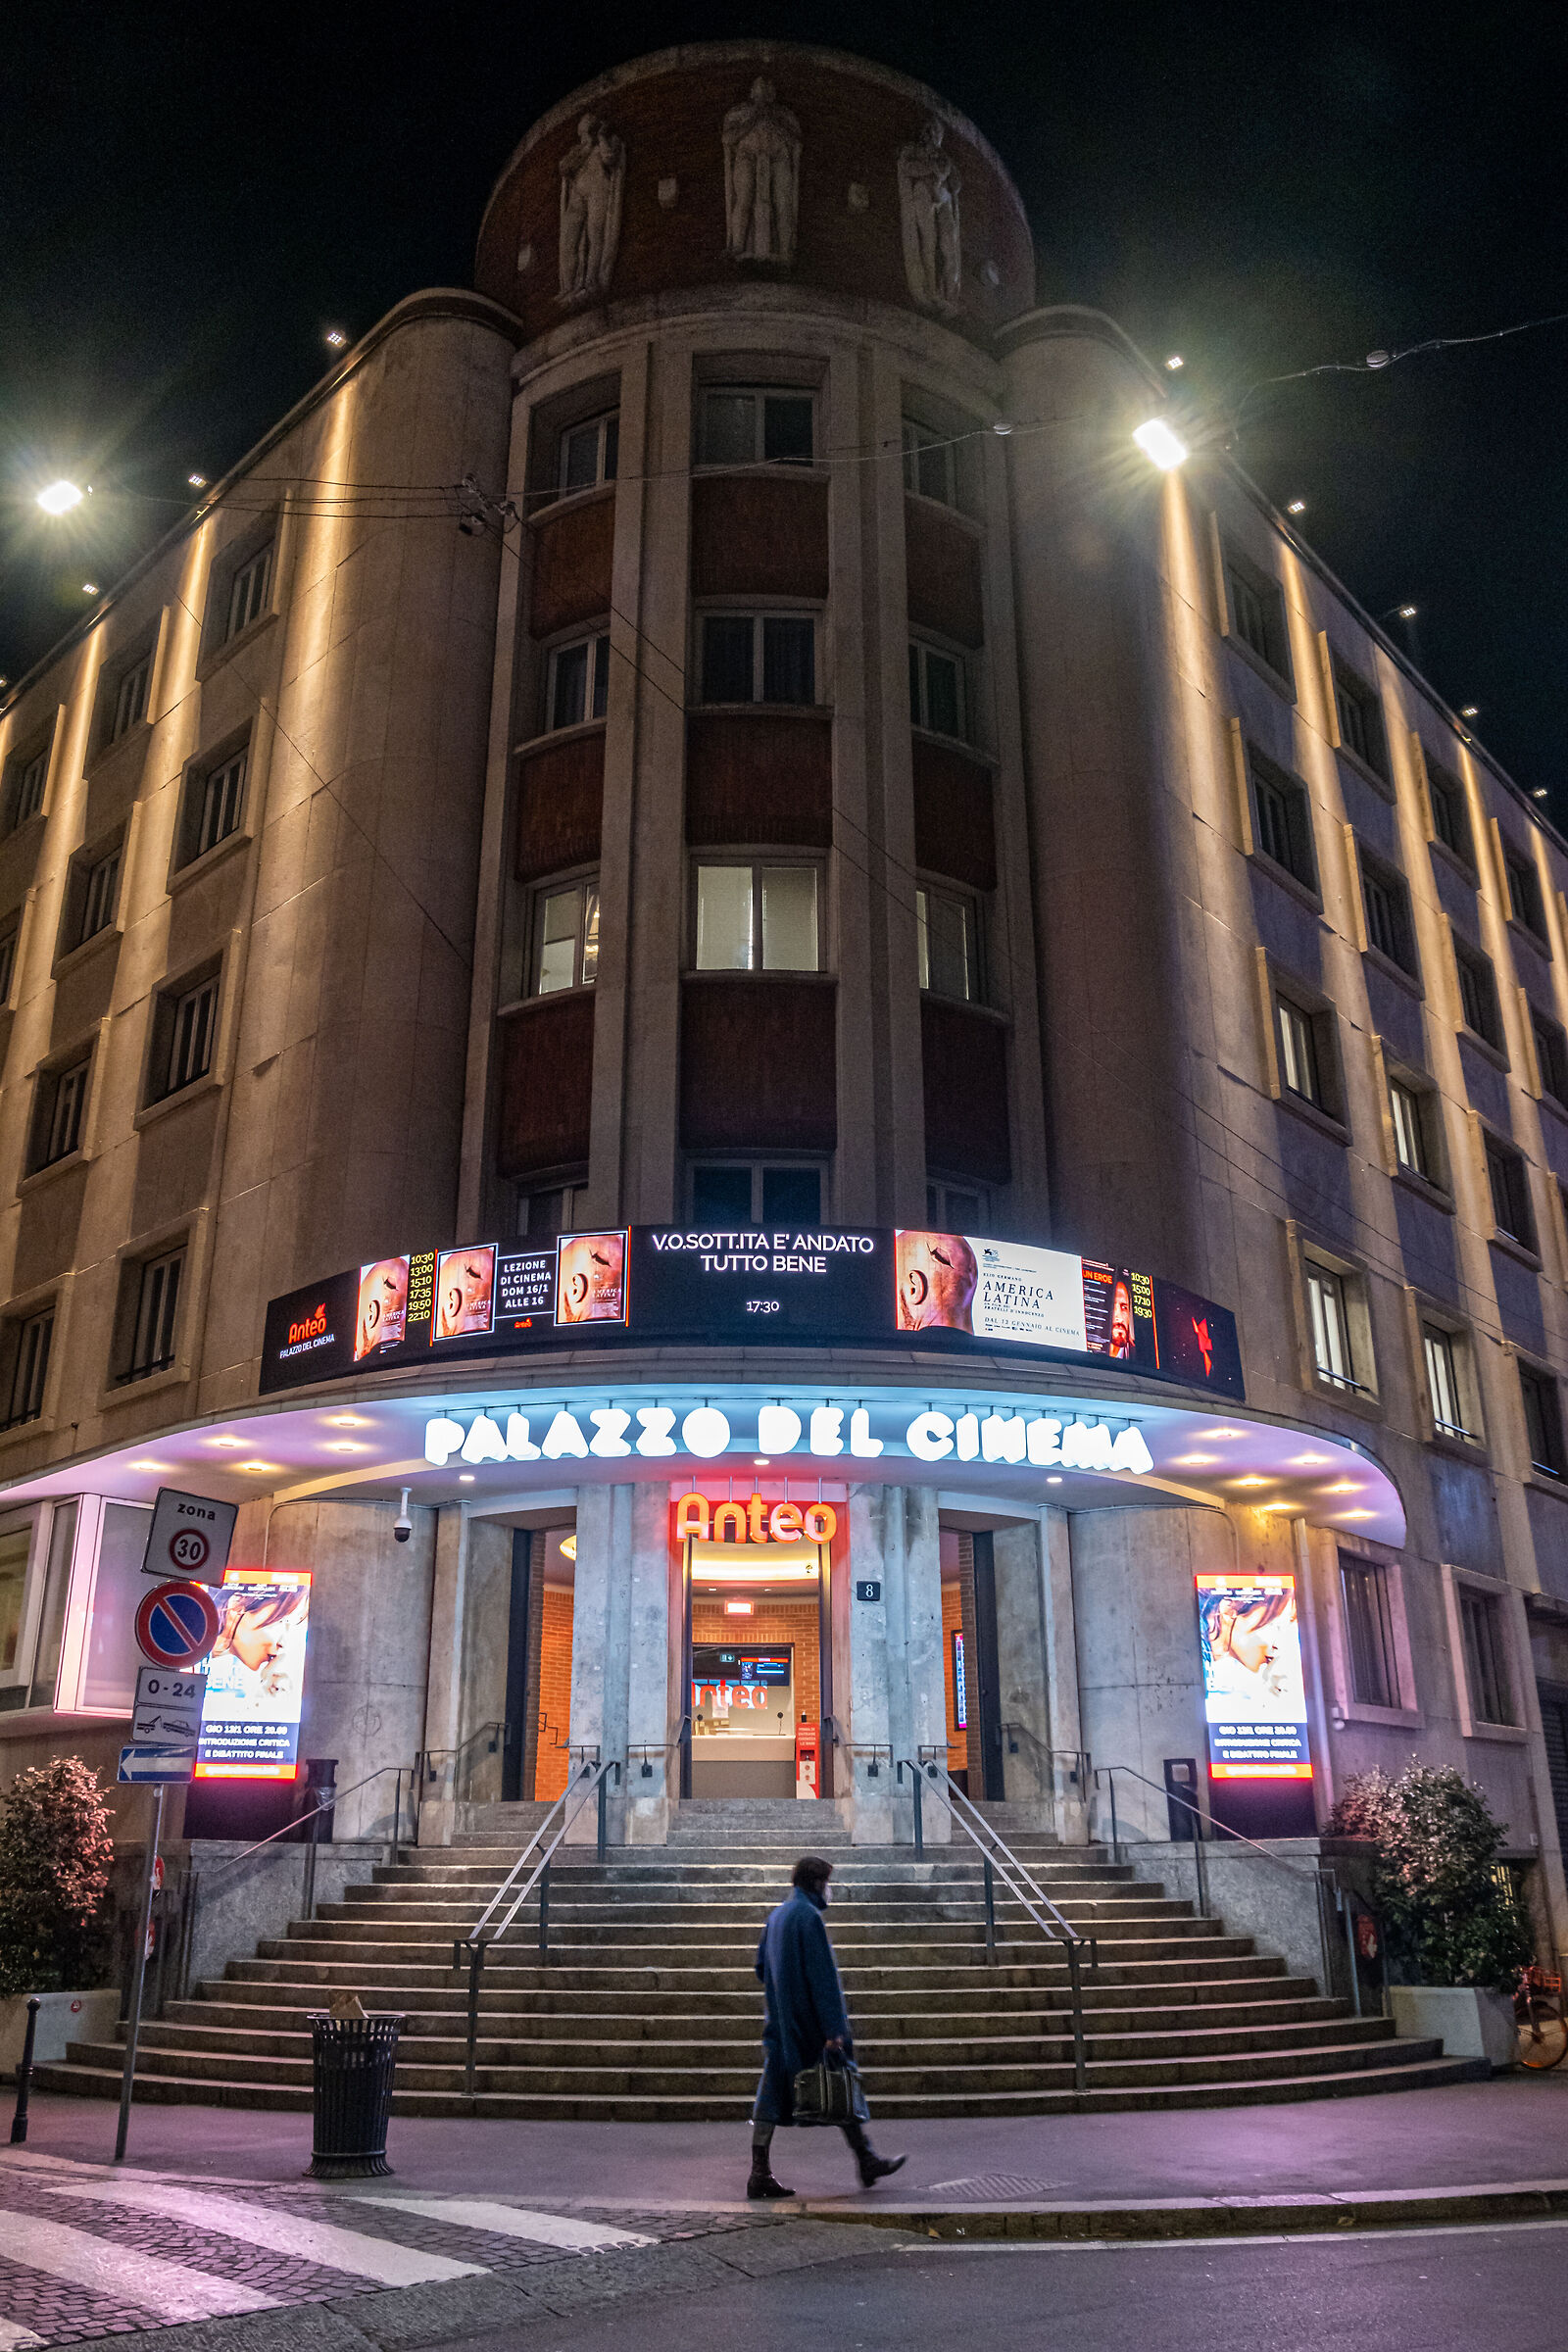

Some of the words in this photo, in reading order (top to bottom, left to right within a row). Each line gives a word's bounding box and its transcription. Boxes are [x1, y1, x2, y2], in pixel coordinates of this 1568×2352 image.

[773, 1233, 790, 1250] E'
[792, 1234, 874, 1253] ANDATO
[504, 1259, 546, 1273] LEZIONE
[700, 1254, 768, 1272] TUTTO
[772, 1255, 827, 1273] BENE
[500, 1276, 512, 1286] DI
[513, 1271, 552, 1284] CINEMA
[1083, 1270, 1093, 1280] UN
[1094, 1272, 1113, 1284] EROE
[501, 1286, 524, 1297] DOM
[526, 1284, 549, 1295] 16/1
[983, 1280, 1054, 1300] AMERICA
[505, 1298, 529, 1308] ALLE
[531, 1296, 544, 1305] 16
[746, 1300, 780, 1313] 17:30
[983, 1291, 1040, 1309] LATINA
[288, 1317, 327, 1345] Anteo
[279, 1345, 302, 1358] PALAZZO
[302, 1341, 313, 1351] DEL
[313, 1333, 334, 1348] CINEMA
[424, 1407, 731, 1466] PALAZZO
[758, 1405, 883, 1458] DEL
[906, 1410, 1154, 1475] CINEMA
[177, 1503, 216, 1521] zona
[676, 1492, 838, 1544] Anteo
[177, 1539, 201, 1560] 30
[865, 1584, 874, 1597] 8
[691, 1680, 768, 1710] nteo
[243, 1725, 264, 1735] ORE
[258, 1739, 291, 1747] CRITICA
[205, 1749, 212, 1758] E
[255, 1750, 284, 1759] FINALE
